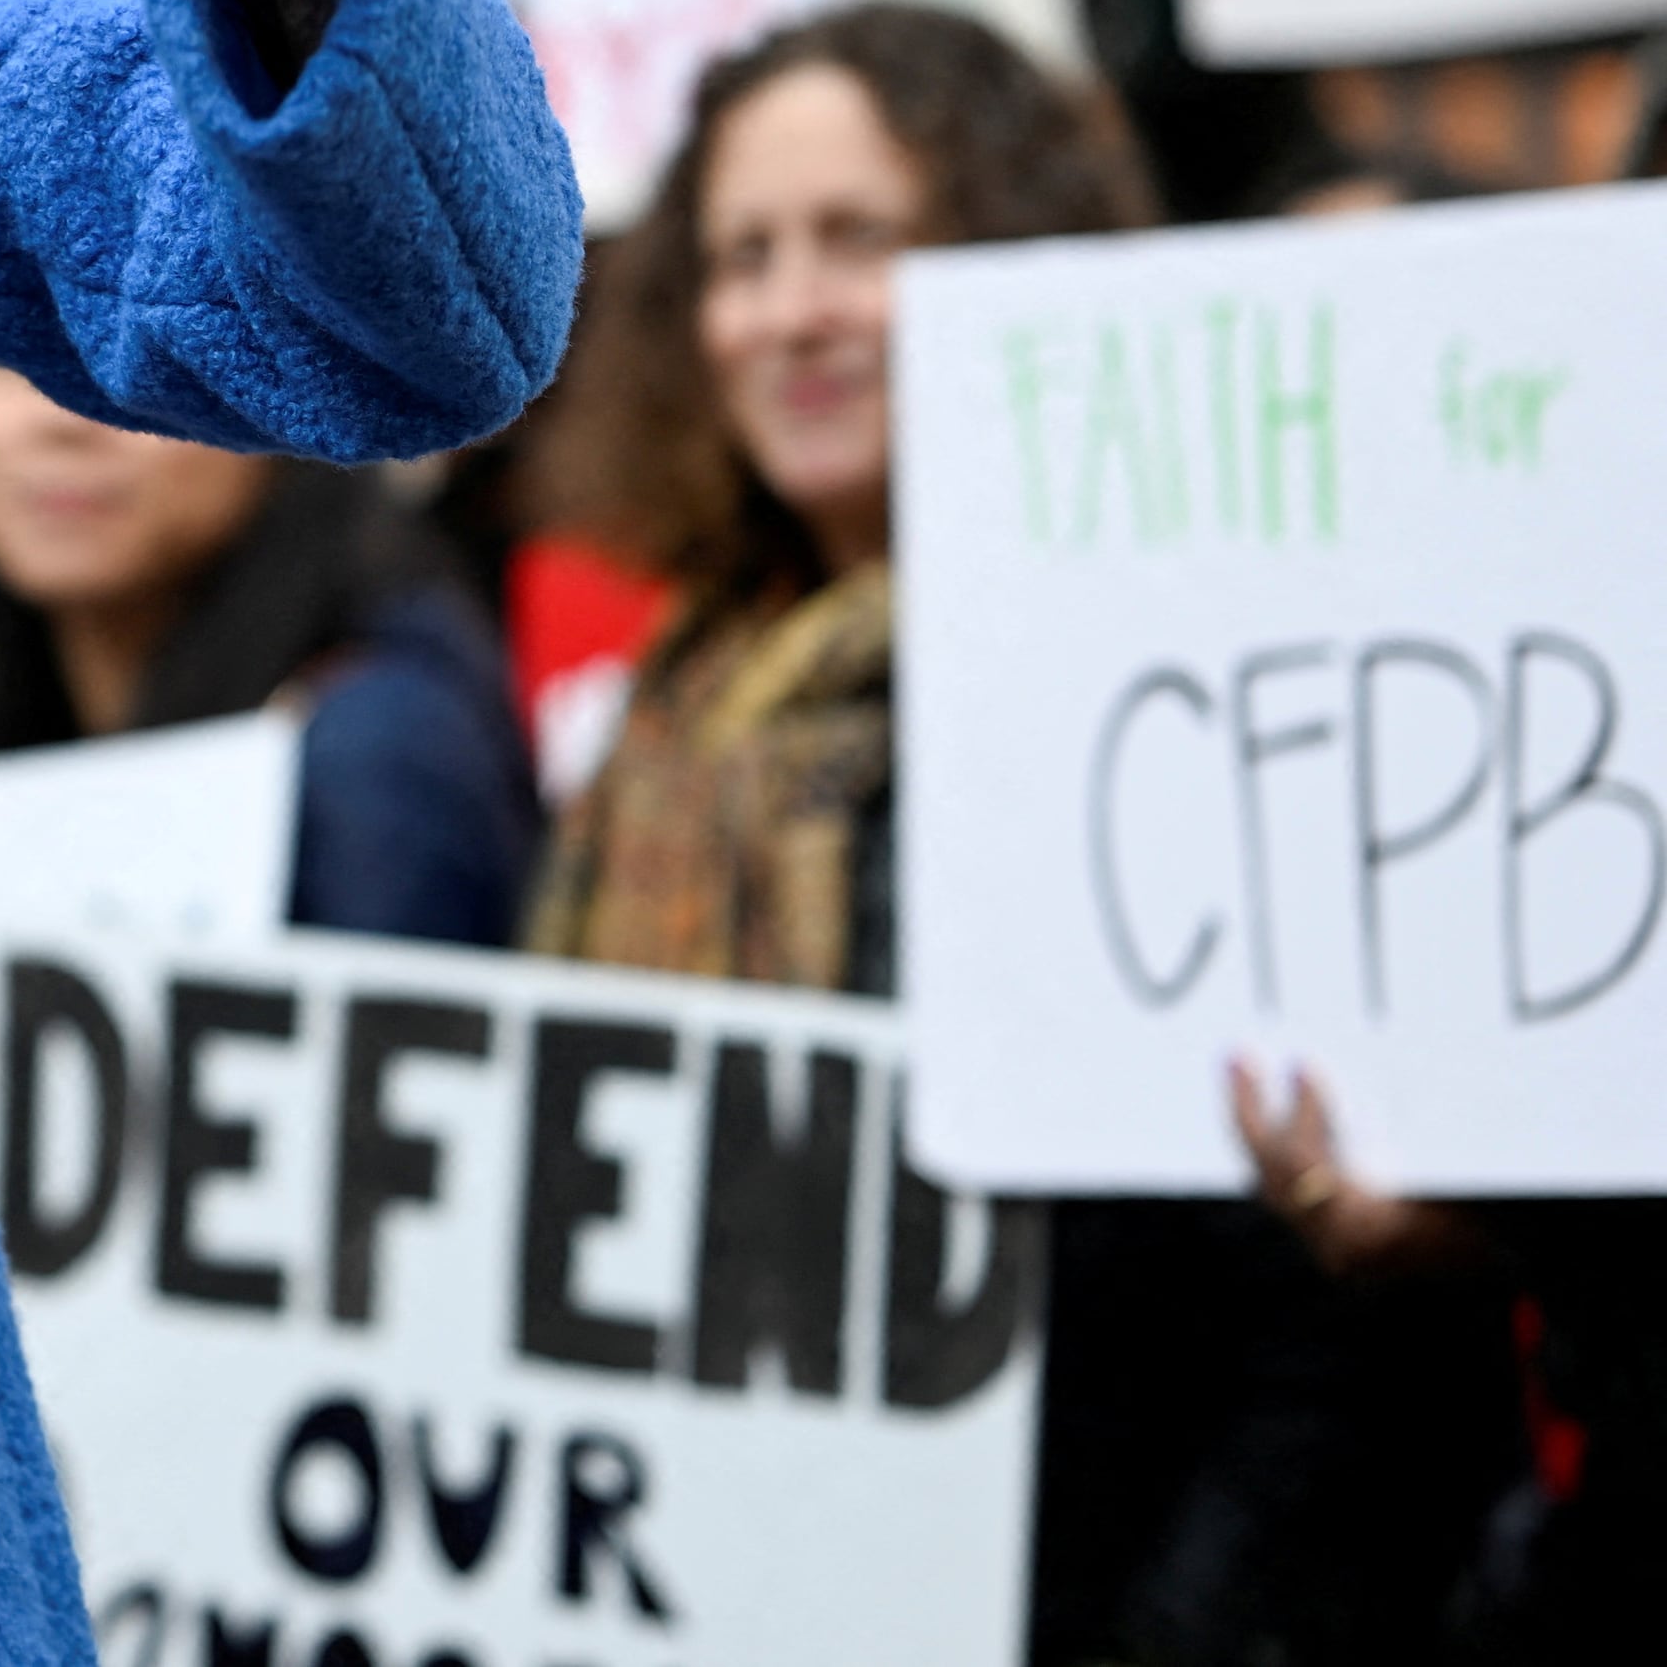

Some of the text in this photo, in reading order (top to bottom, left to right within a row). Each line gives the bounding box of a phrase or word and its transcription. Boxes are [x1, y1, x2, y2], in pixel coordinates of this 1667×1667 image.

[1005, 296, 1572, 549] FAITH for
[1087, 626, 1667, 1026] CFPB
[2, 956, 1052, 1414] DEFEND
[270, 1394, 679, 1624] OUR
